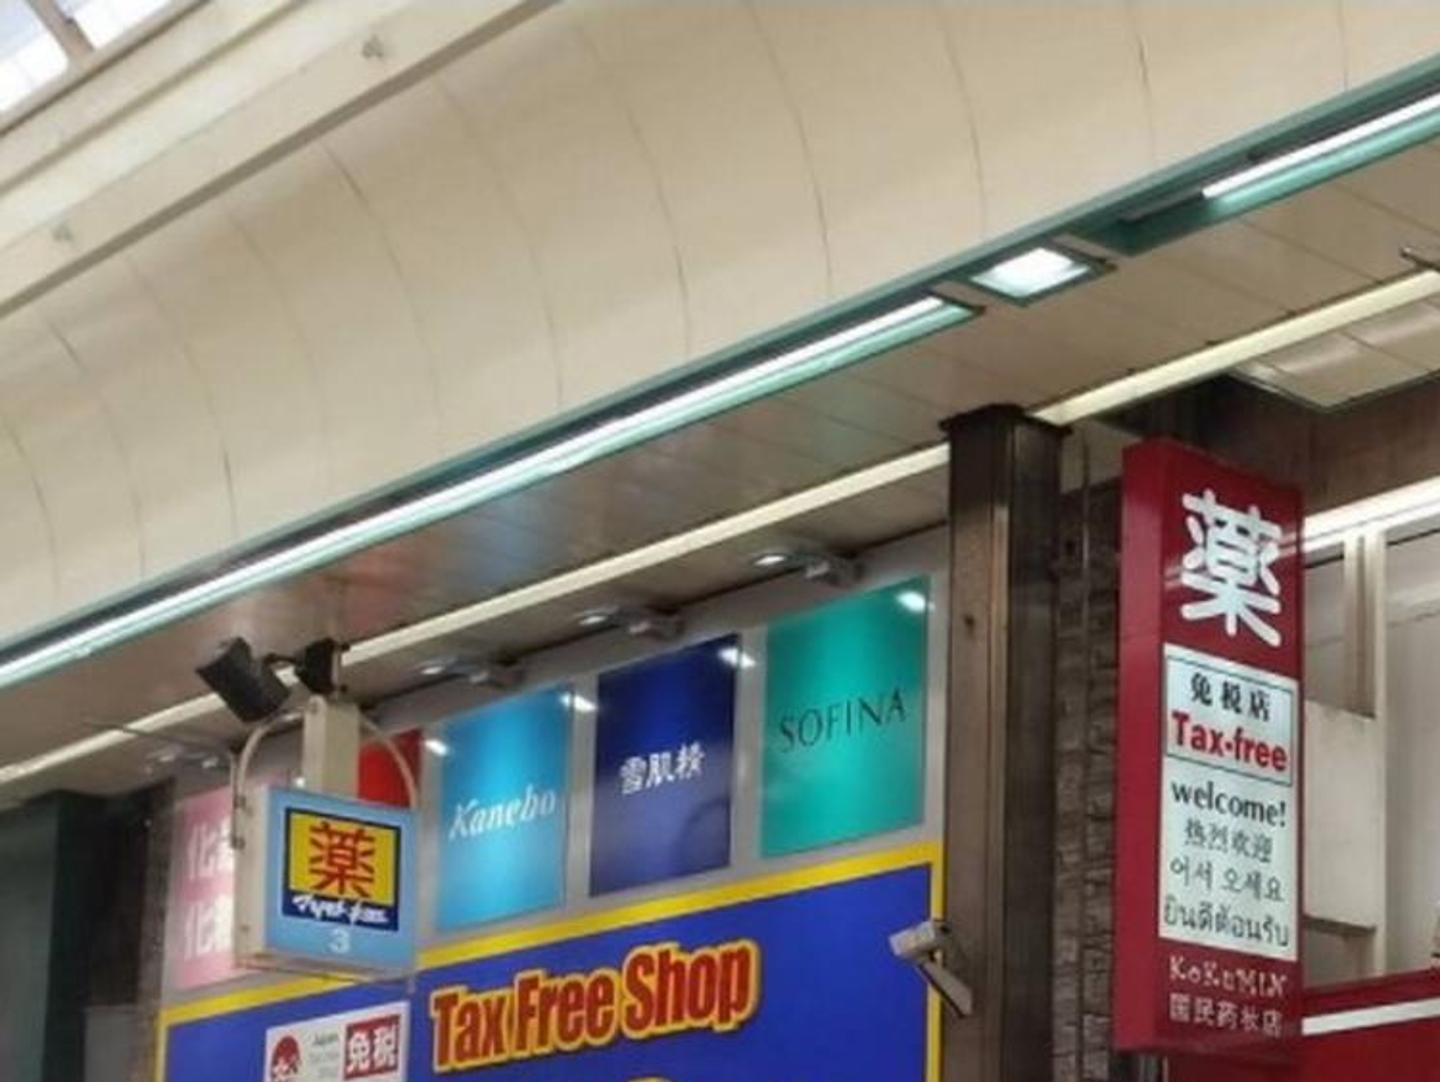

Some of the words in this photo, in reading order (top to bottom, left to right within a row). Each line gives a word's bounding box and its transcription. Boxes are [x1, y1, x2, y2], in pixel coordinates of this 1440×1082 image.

[1181, 488, 1282, 648] 薬
[779, 687, 907, 753] SOFINA
[1172, 710, 1288, 772] Tax-free
[448, 785, 556, 842] Kanebo
[1171, 780, 1287, 828] welcome!
[308, 820, 376, 899] 薬
[1170, 855, 1213, 891] 어서
[1221, 867, 1286, 903] 오세요
[329, 929, 350, 951] 3
[621, 940, 759, 1038] Shop
